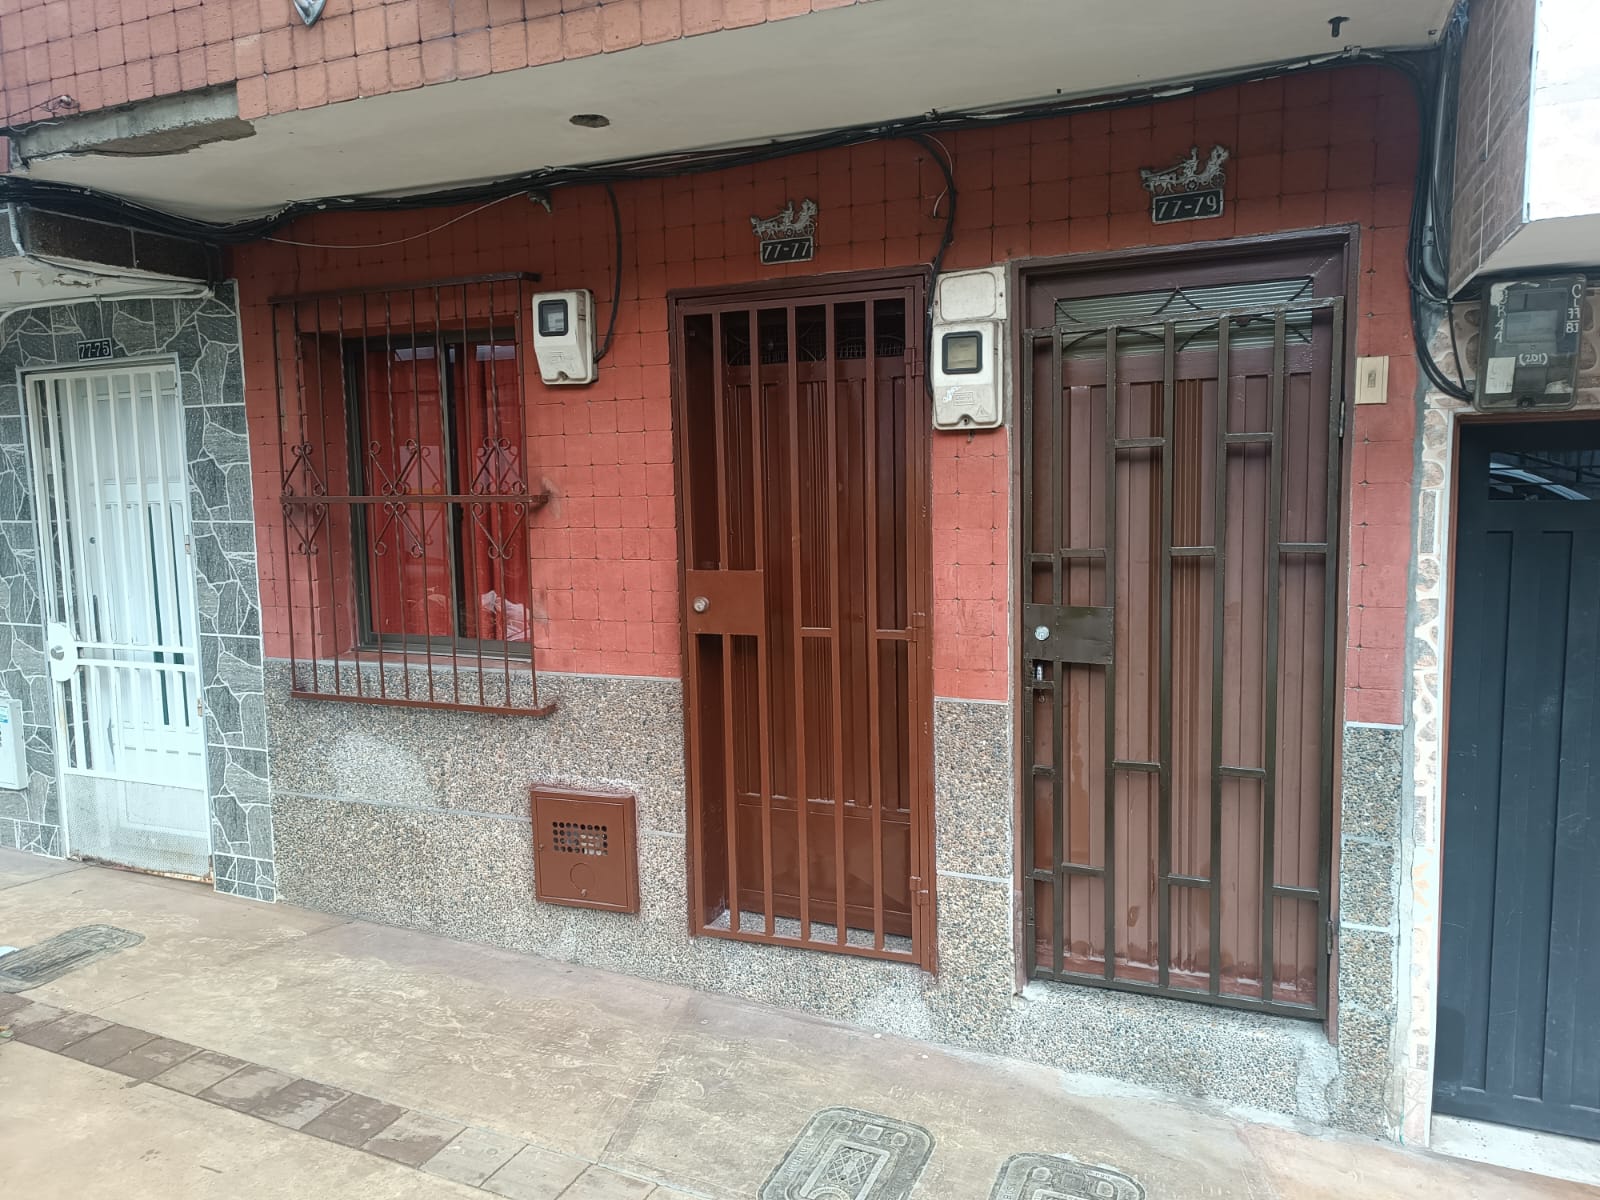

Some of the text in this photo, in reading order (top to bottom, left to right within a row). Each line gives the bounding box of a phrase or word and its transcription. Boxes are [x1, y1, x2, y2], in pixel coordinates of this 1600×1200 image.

[1158, 195, 1217, 219] 77-79
[764, 242, 810, 260] 77-77
[79, 341, 110, 358] 77-75
